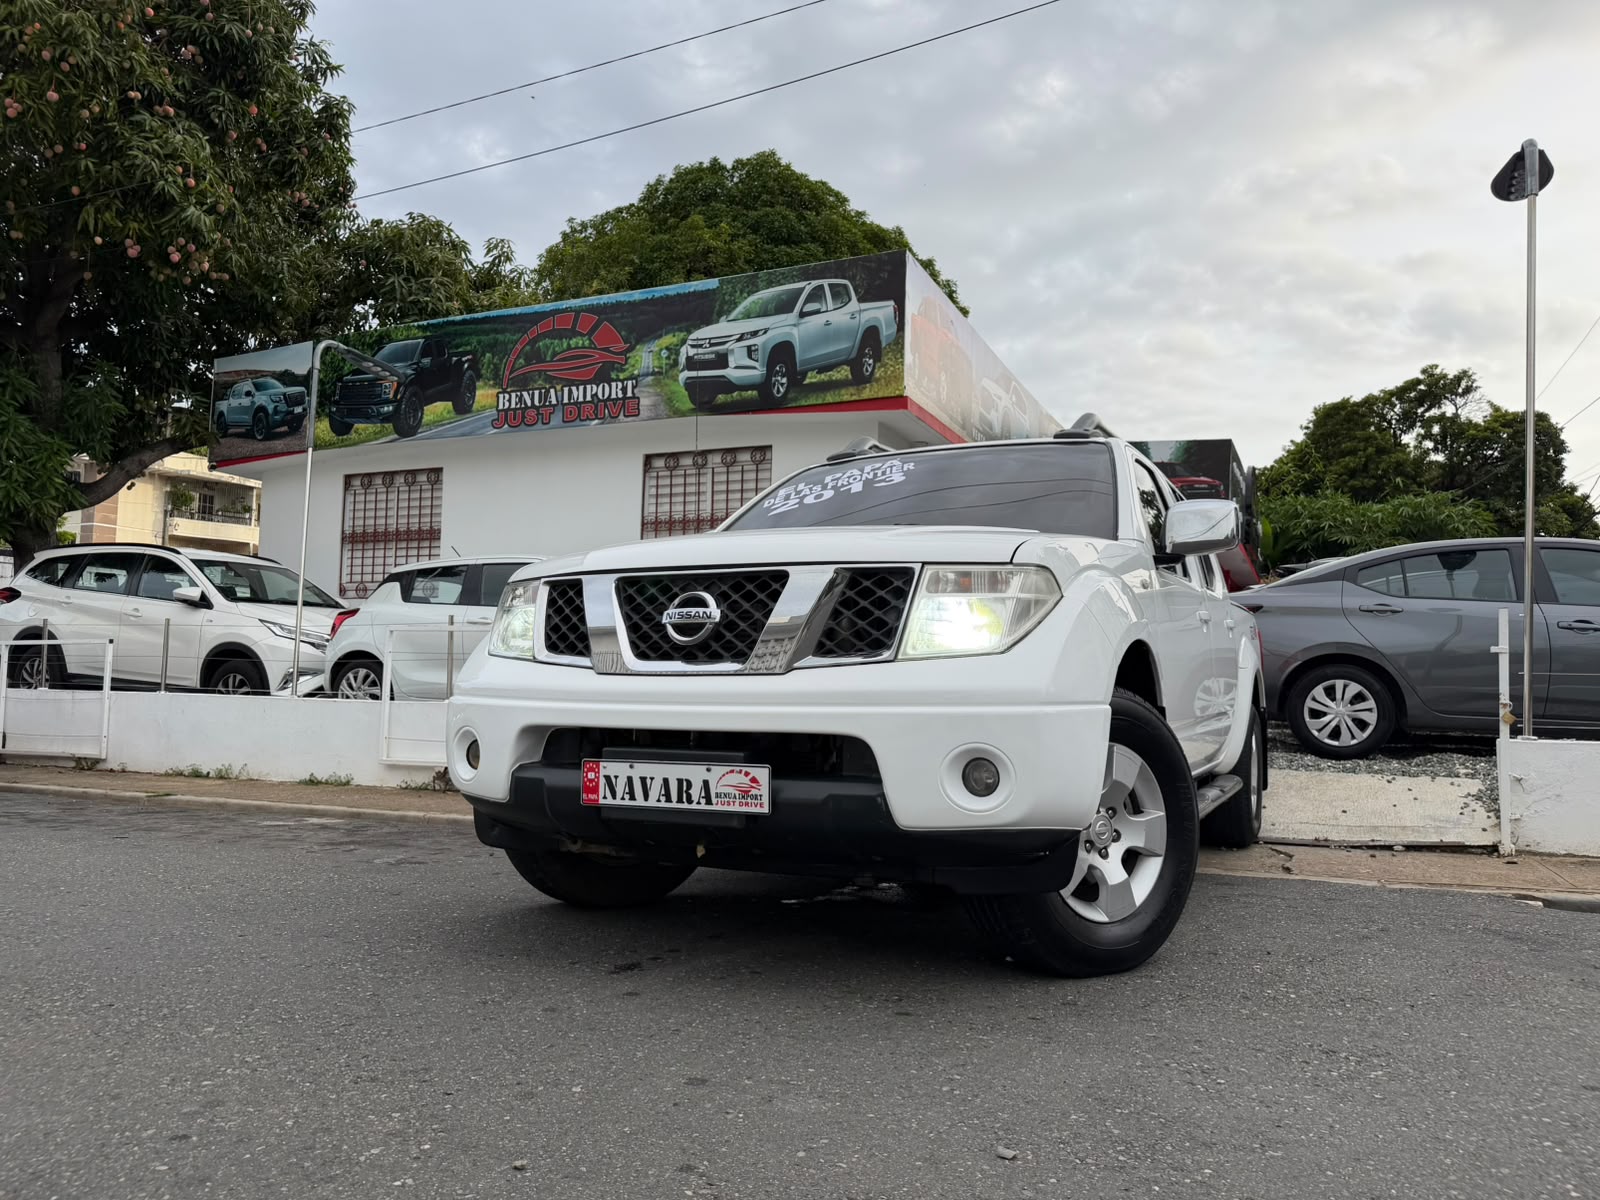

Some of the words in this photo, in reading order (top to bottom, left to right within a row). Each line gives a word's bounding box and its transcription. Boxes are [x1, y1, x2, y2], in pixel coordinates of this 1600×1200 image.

[497, 388, 558, 410] BENUA
[562, 380, 636, 404] IMPORT
[492, 407, 554, 428] JUST
[564, 399, 639, 421] DRIVE
[763, 493, 786, 508] DE
[790, 484, 822, 499] LAS
[827, 462, 916, 489] FRONTIER
[768, 472, 906, 516] 2013
[776, 482, 814, 500] EL
[665, 610, 712, 620] NISSAN
[602, 774, 714, 806] NAVARA
[714, 791, 737, 800] BENUA
[738, 792, 763, 801] IMPORT
